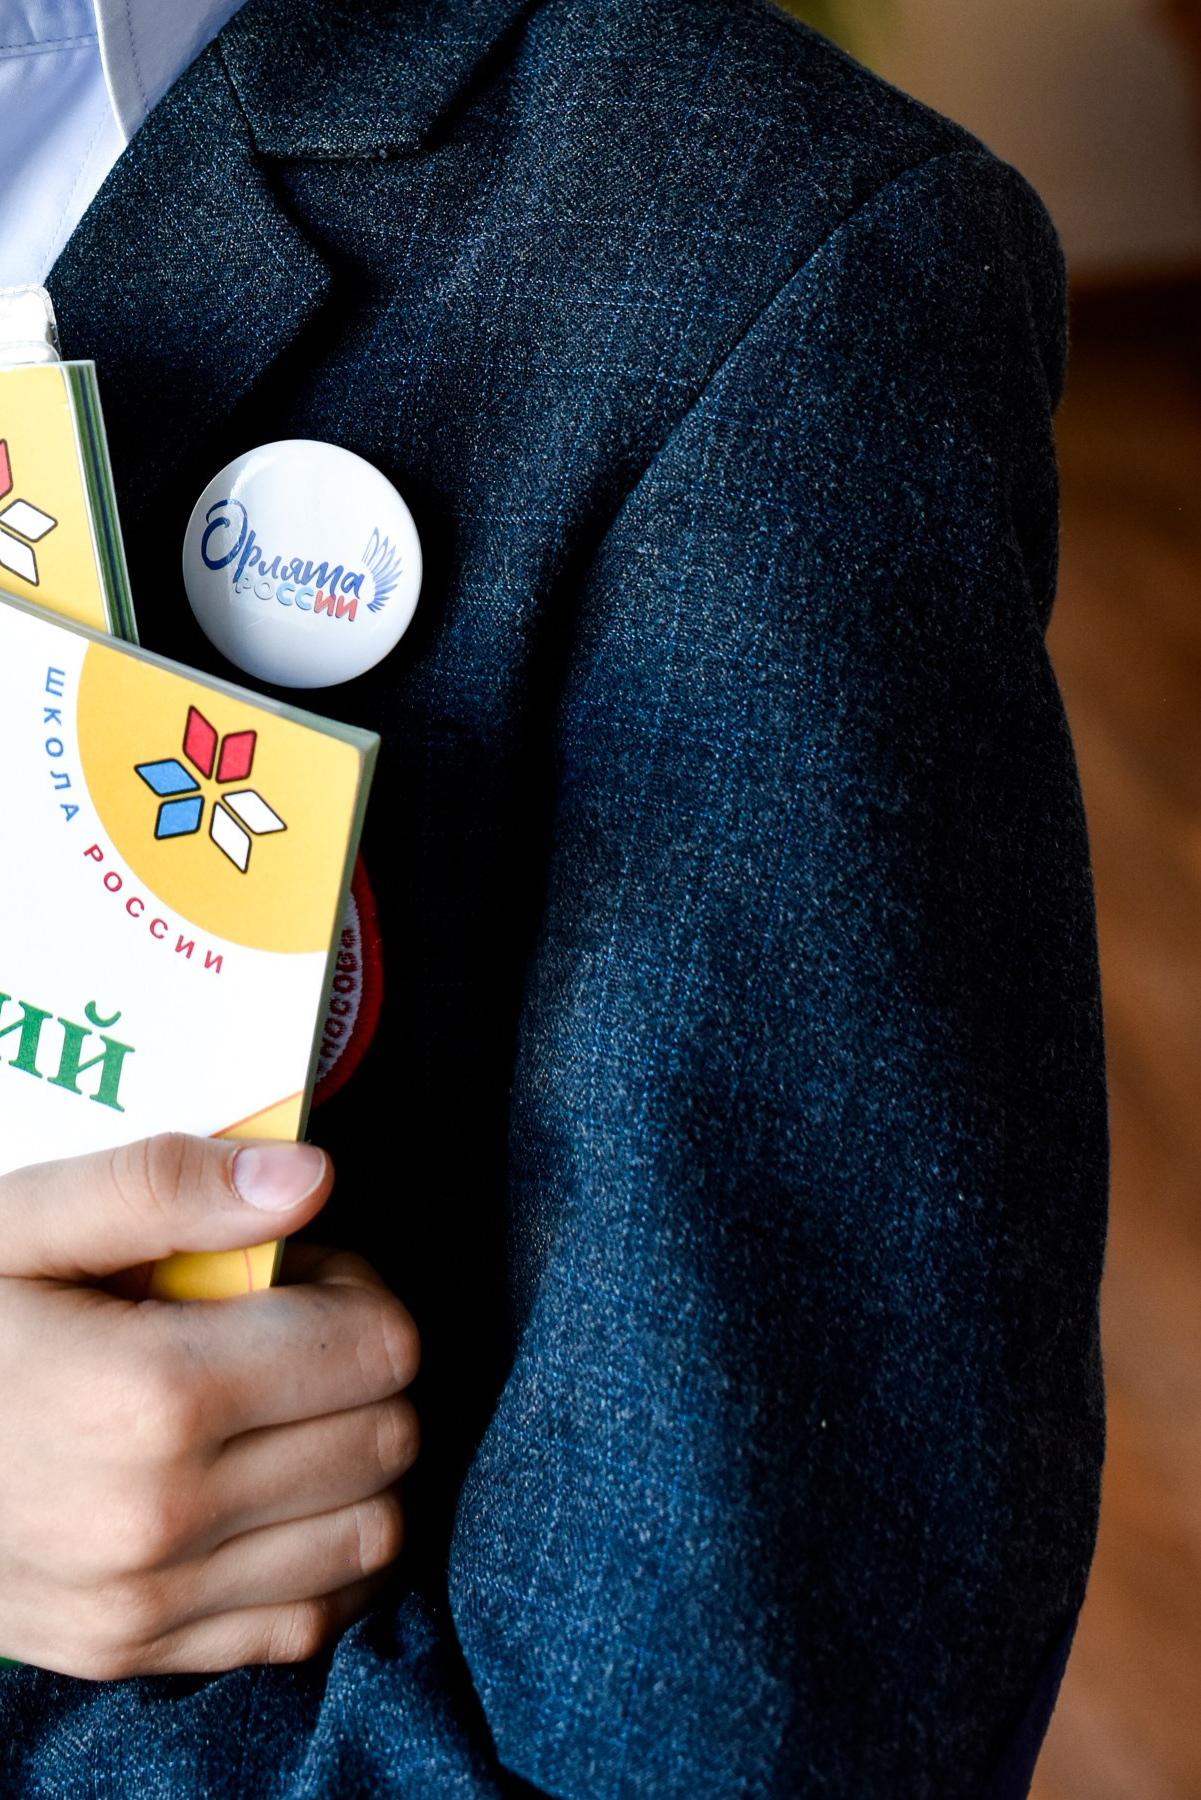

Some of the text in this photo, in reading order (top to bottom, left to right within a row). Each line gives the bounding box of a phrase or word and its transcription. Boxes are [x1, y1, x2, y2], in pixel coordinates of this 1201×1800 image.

[200, 499, 366, 600] Орлята
[44, 666, 224, 974] ШКОЛА РОССИИ
